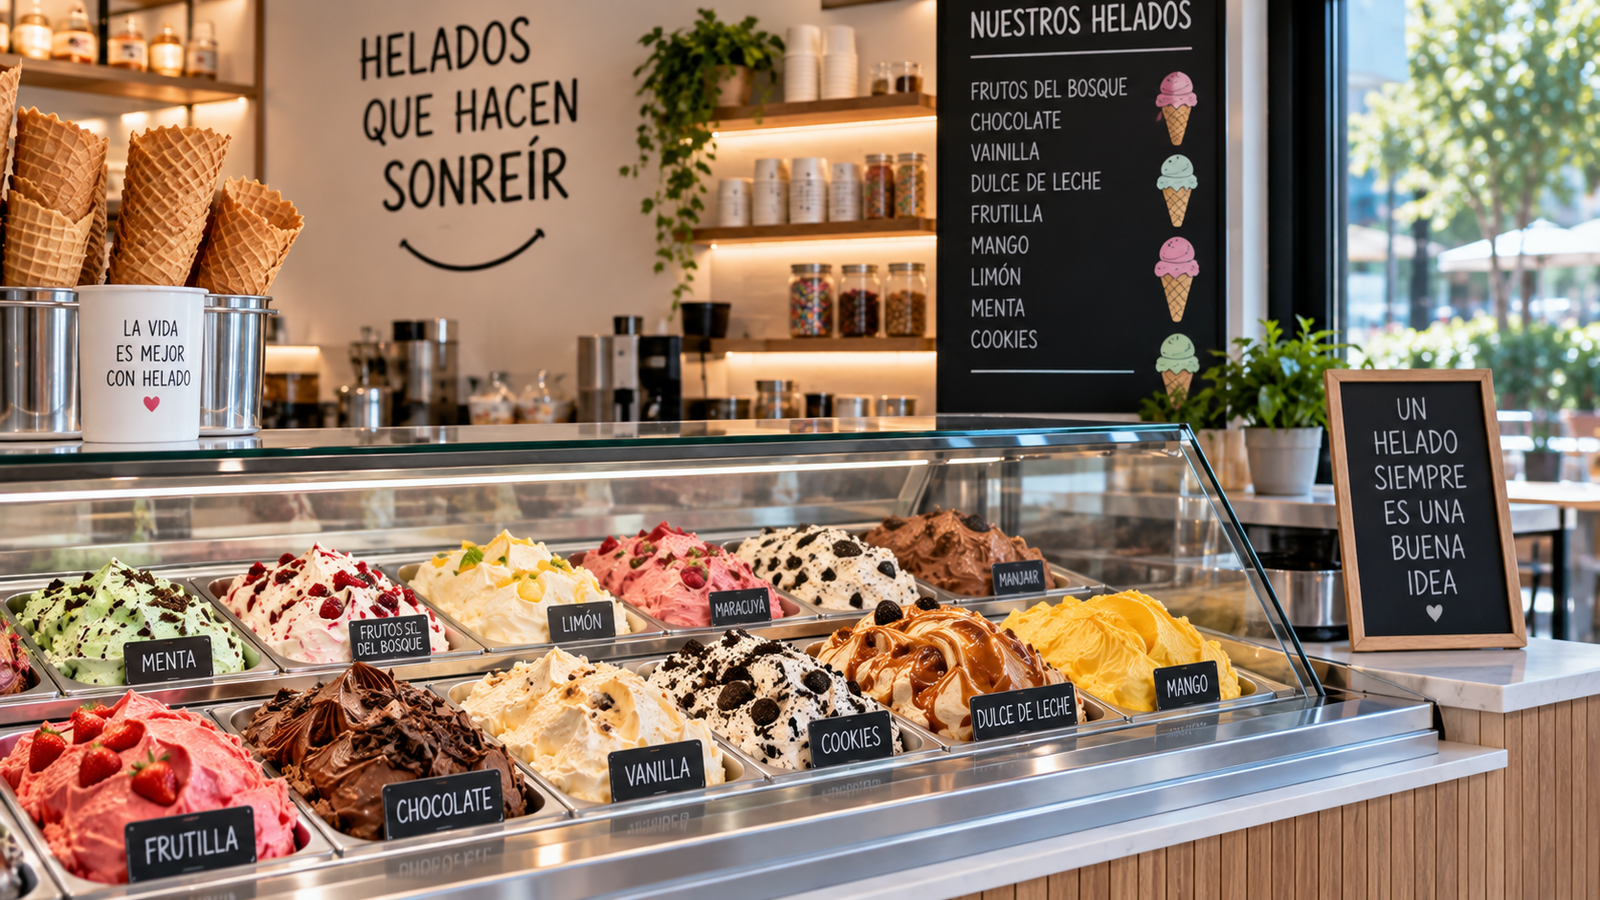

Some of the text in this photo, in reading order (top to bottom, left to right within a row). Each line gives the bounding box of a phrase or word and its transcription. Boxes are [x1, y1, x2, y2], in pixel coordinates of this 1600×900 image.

[970, 0, 1192, 39] NUESTROS HELADOS
[360, 16, 531, 81] HELADOS
[971, 76, 1128, 101] FRUTOS DEL BOSQUE
[363, 78, 578, 147] QUE HACEN
[970, 110, 1062, 132] CHOCOLATE
[970, 141, 1040, 162] VAINILLA
[381, 134, 570, 213] SONREÍR
[971, 170, 1102, 193] DULCE DE LECHE
[971, 203, 1043, 224] FRUTILLA
[971, 235, 1029, 255] MANGO
[971, 262, 1021, 287] LIMÓN
[971, 298, 1026, 318] MENTA
[123, 319, 178, 337] LA VIDA
[970, 329, 1038, 349] COOKIES
[116, 344, 185, 363] ES MEJOR
[106, 369, 191, 387] CON HELADO
[1396, 396, 1427, 421] UN
[1373, 429, 1458, 455] HELADO
[1374, 464, 1467, 491] SIEMPRE
[1383, 498, 1466, 525] ES UNA
[1390, 533, 1466, 561] BUENA
[1407, 569, 1458, 596] IDEA
[361, 622, 402, 640] FRUTOS
[562, 610, 601, 632] LIMÓN
[358, 637, 423, 656] DEL BOSQUE
[143, 650, 196, 672] MENTA
[1167, 674, 1207, 697] MANGO
[977, 696, 1072, 728] DULCE DE LECHE
[822, 726, 880, 754] COOKIES
[625, 757, 690, 786] VANILLA
[397, 786, 492, 824] CHOCOLATE
[146, 826, 238, 864] FRUTILLA
